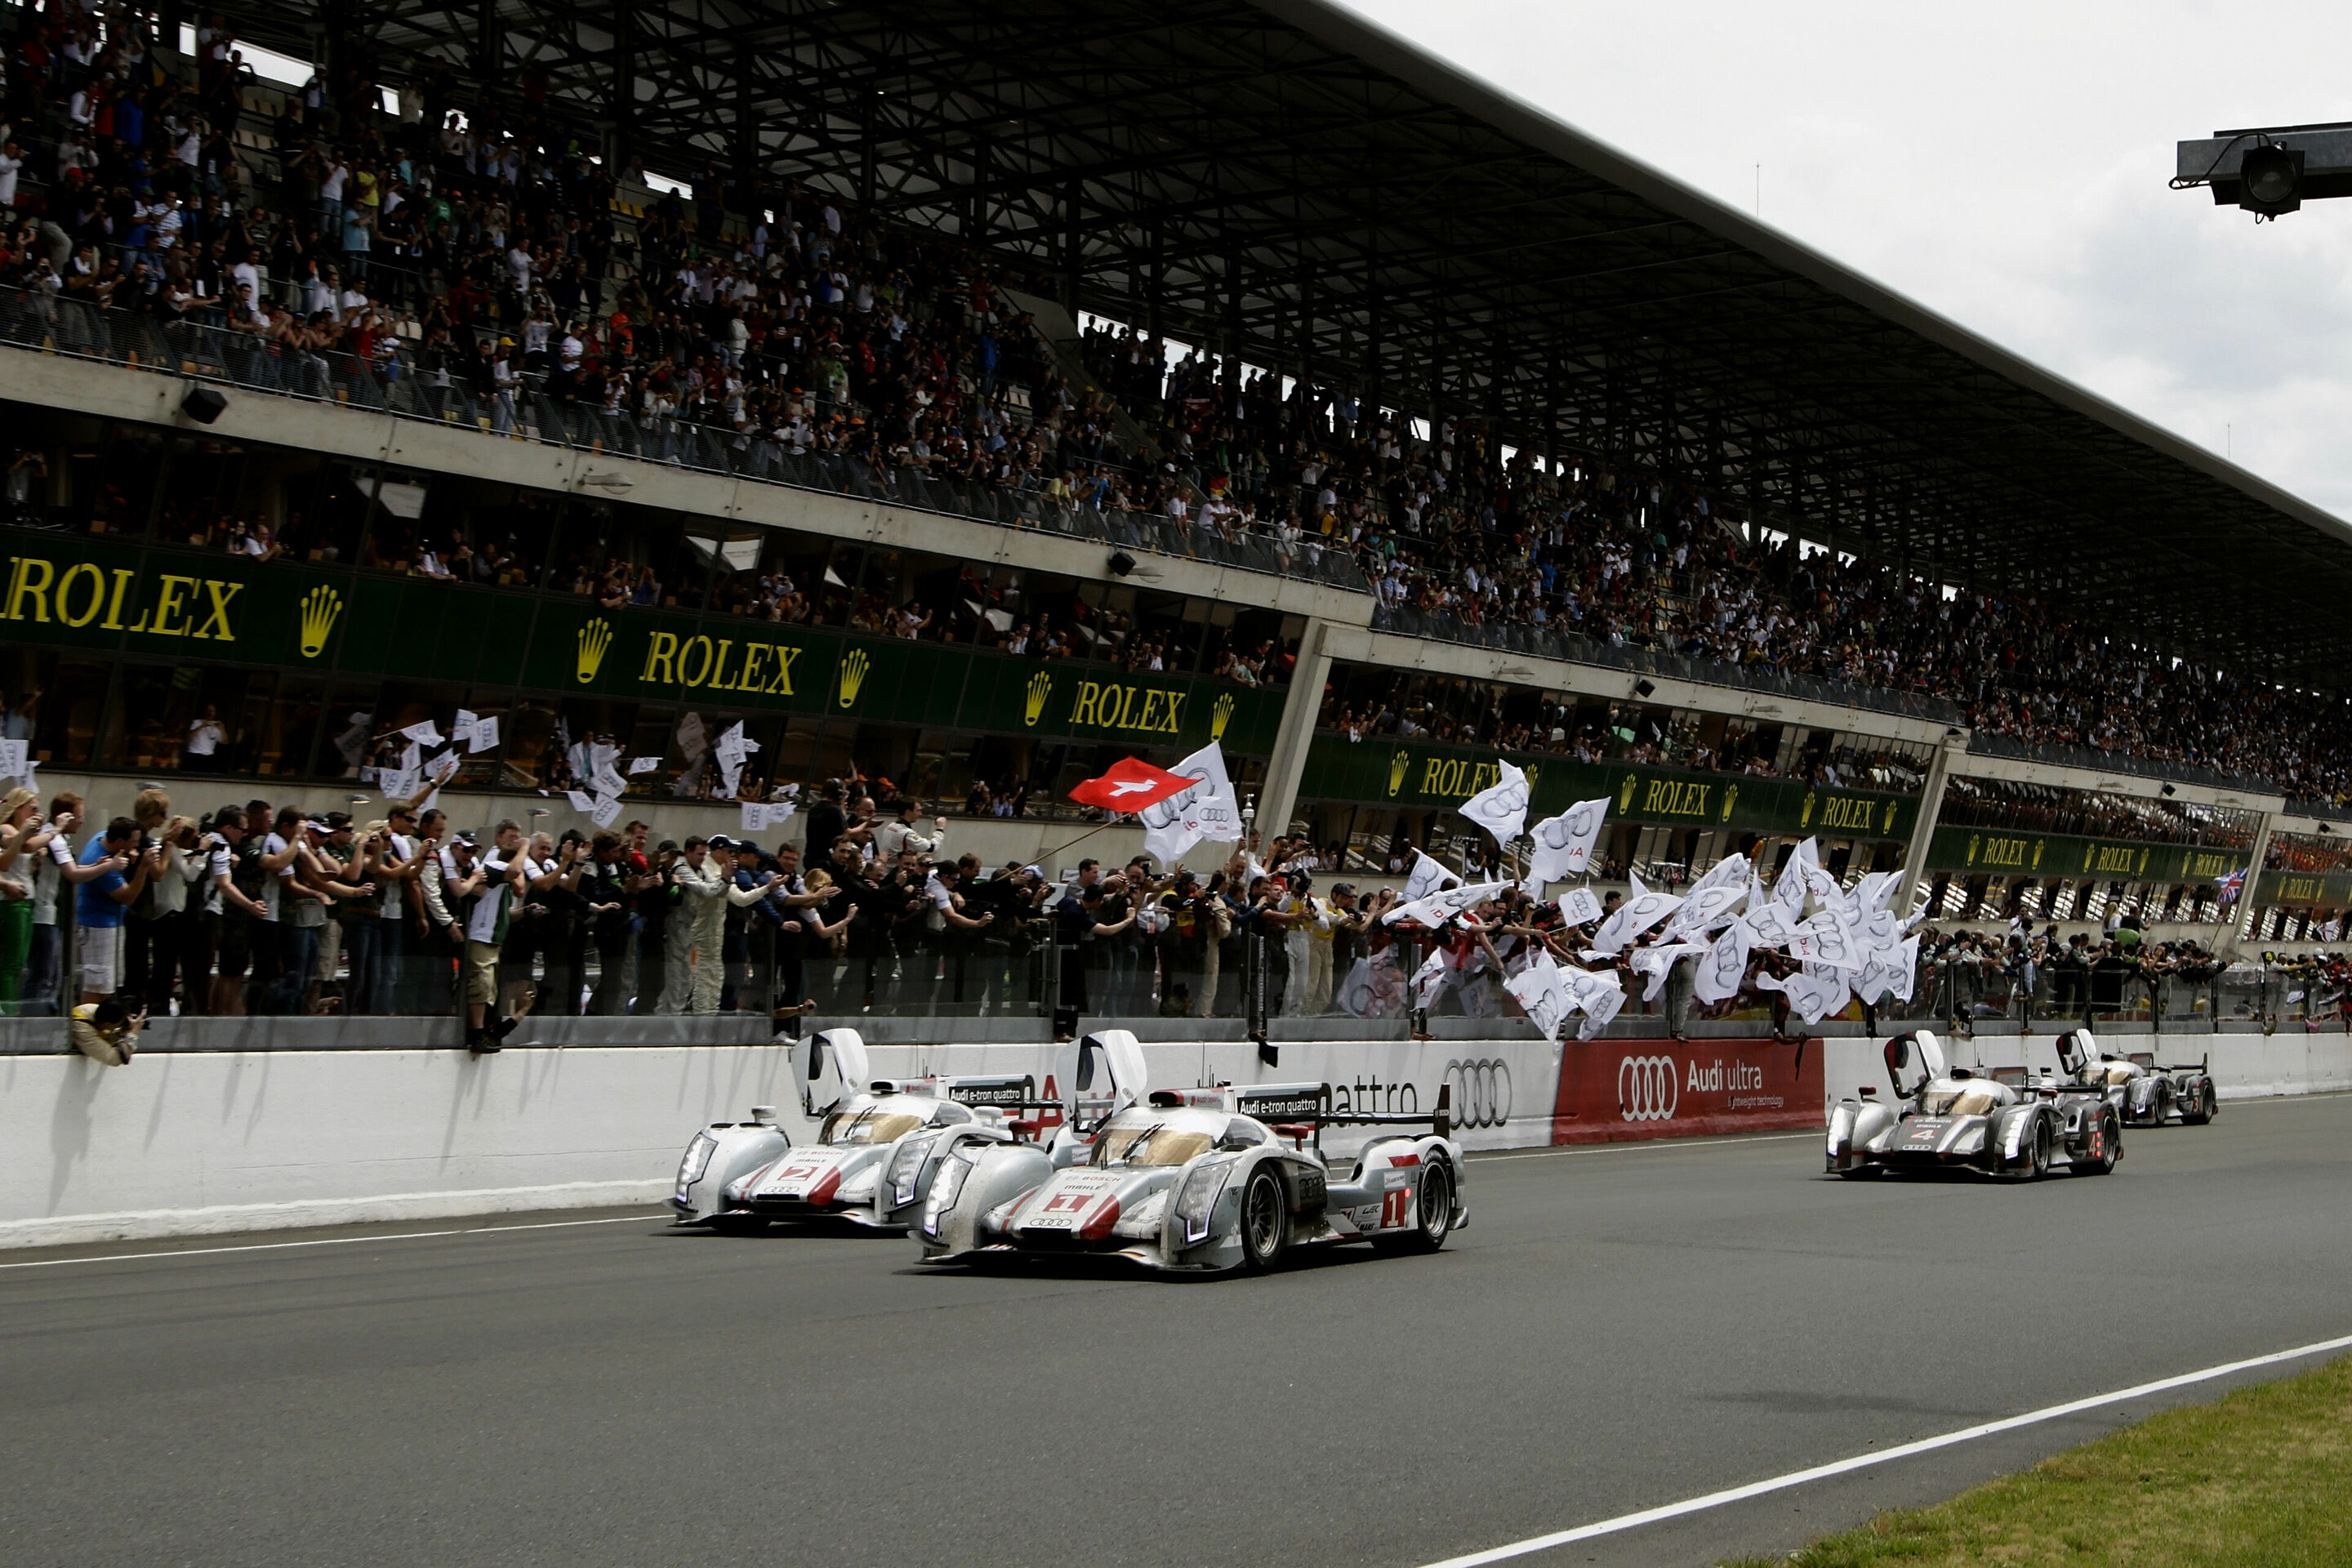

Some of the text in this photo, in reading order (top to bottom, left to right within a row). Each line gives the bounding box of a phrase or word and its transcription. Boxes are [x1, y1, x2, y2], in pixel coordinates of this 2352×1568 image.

[0, 557, 244, 641] ROLEX
[639, 631, 802, 696] ROLEX
[1069, 681, 1187, 733] ROLEX
[1642, 780, 1711, 815] ROLEX
[1820, 797, 1875, 829] ROLEX
[1983, 838, 2027, 866] ROLEX
[2096, 847, 2135, 873] ROLEX
[2194, 853, 2225, 877] ROLEX
[2286, 879, 2315, 899] ROLEX
[1687, 1058, 1762, 1092] Audi ultra
[951, 1088, 1020, 1102] Audi e-tron quattro
[1241, 1099, 1316, 1114] Audi e-tron quattro
[2193, 1098, 2199, 1111] 3
[1911, 1129, 1934, 1140] 4
[2089, 1134, 2096, 1156] 4
[781, 1167, 812, 1181] 2
[1049, 1195, 1079, 1212] 1
[1387, 1192, 1399, 1227] 1
